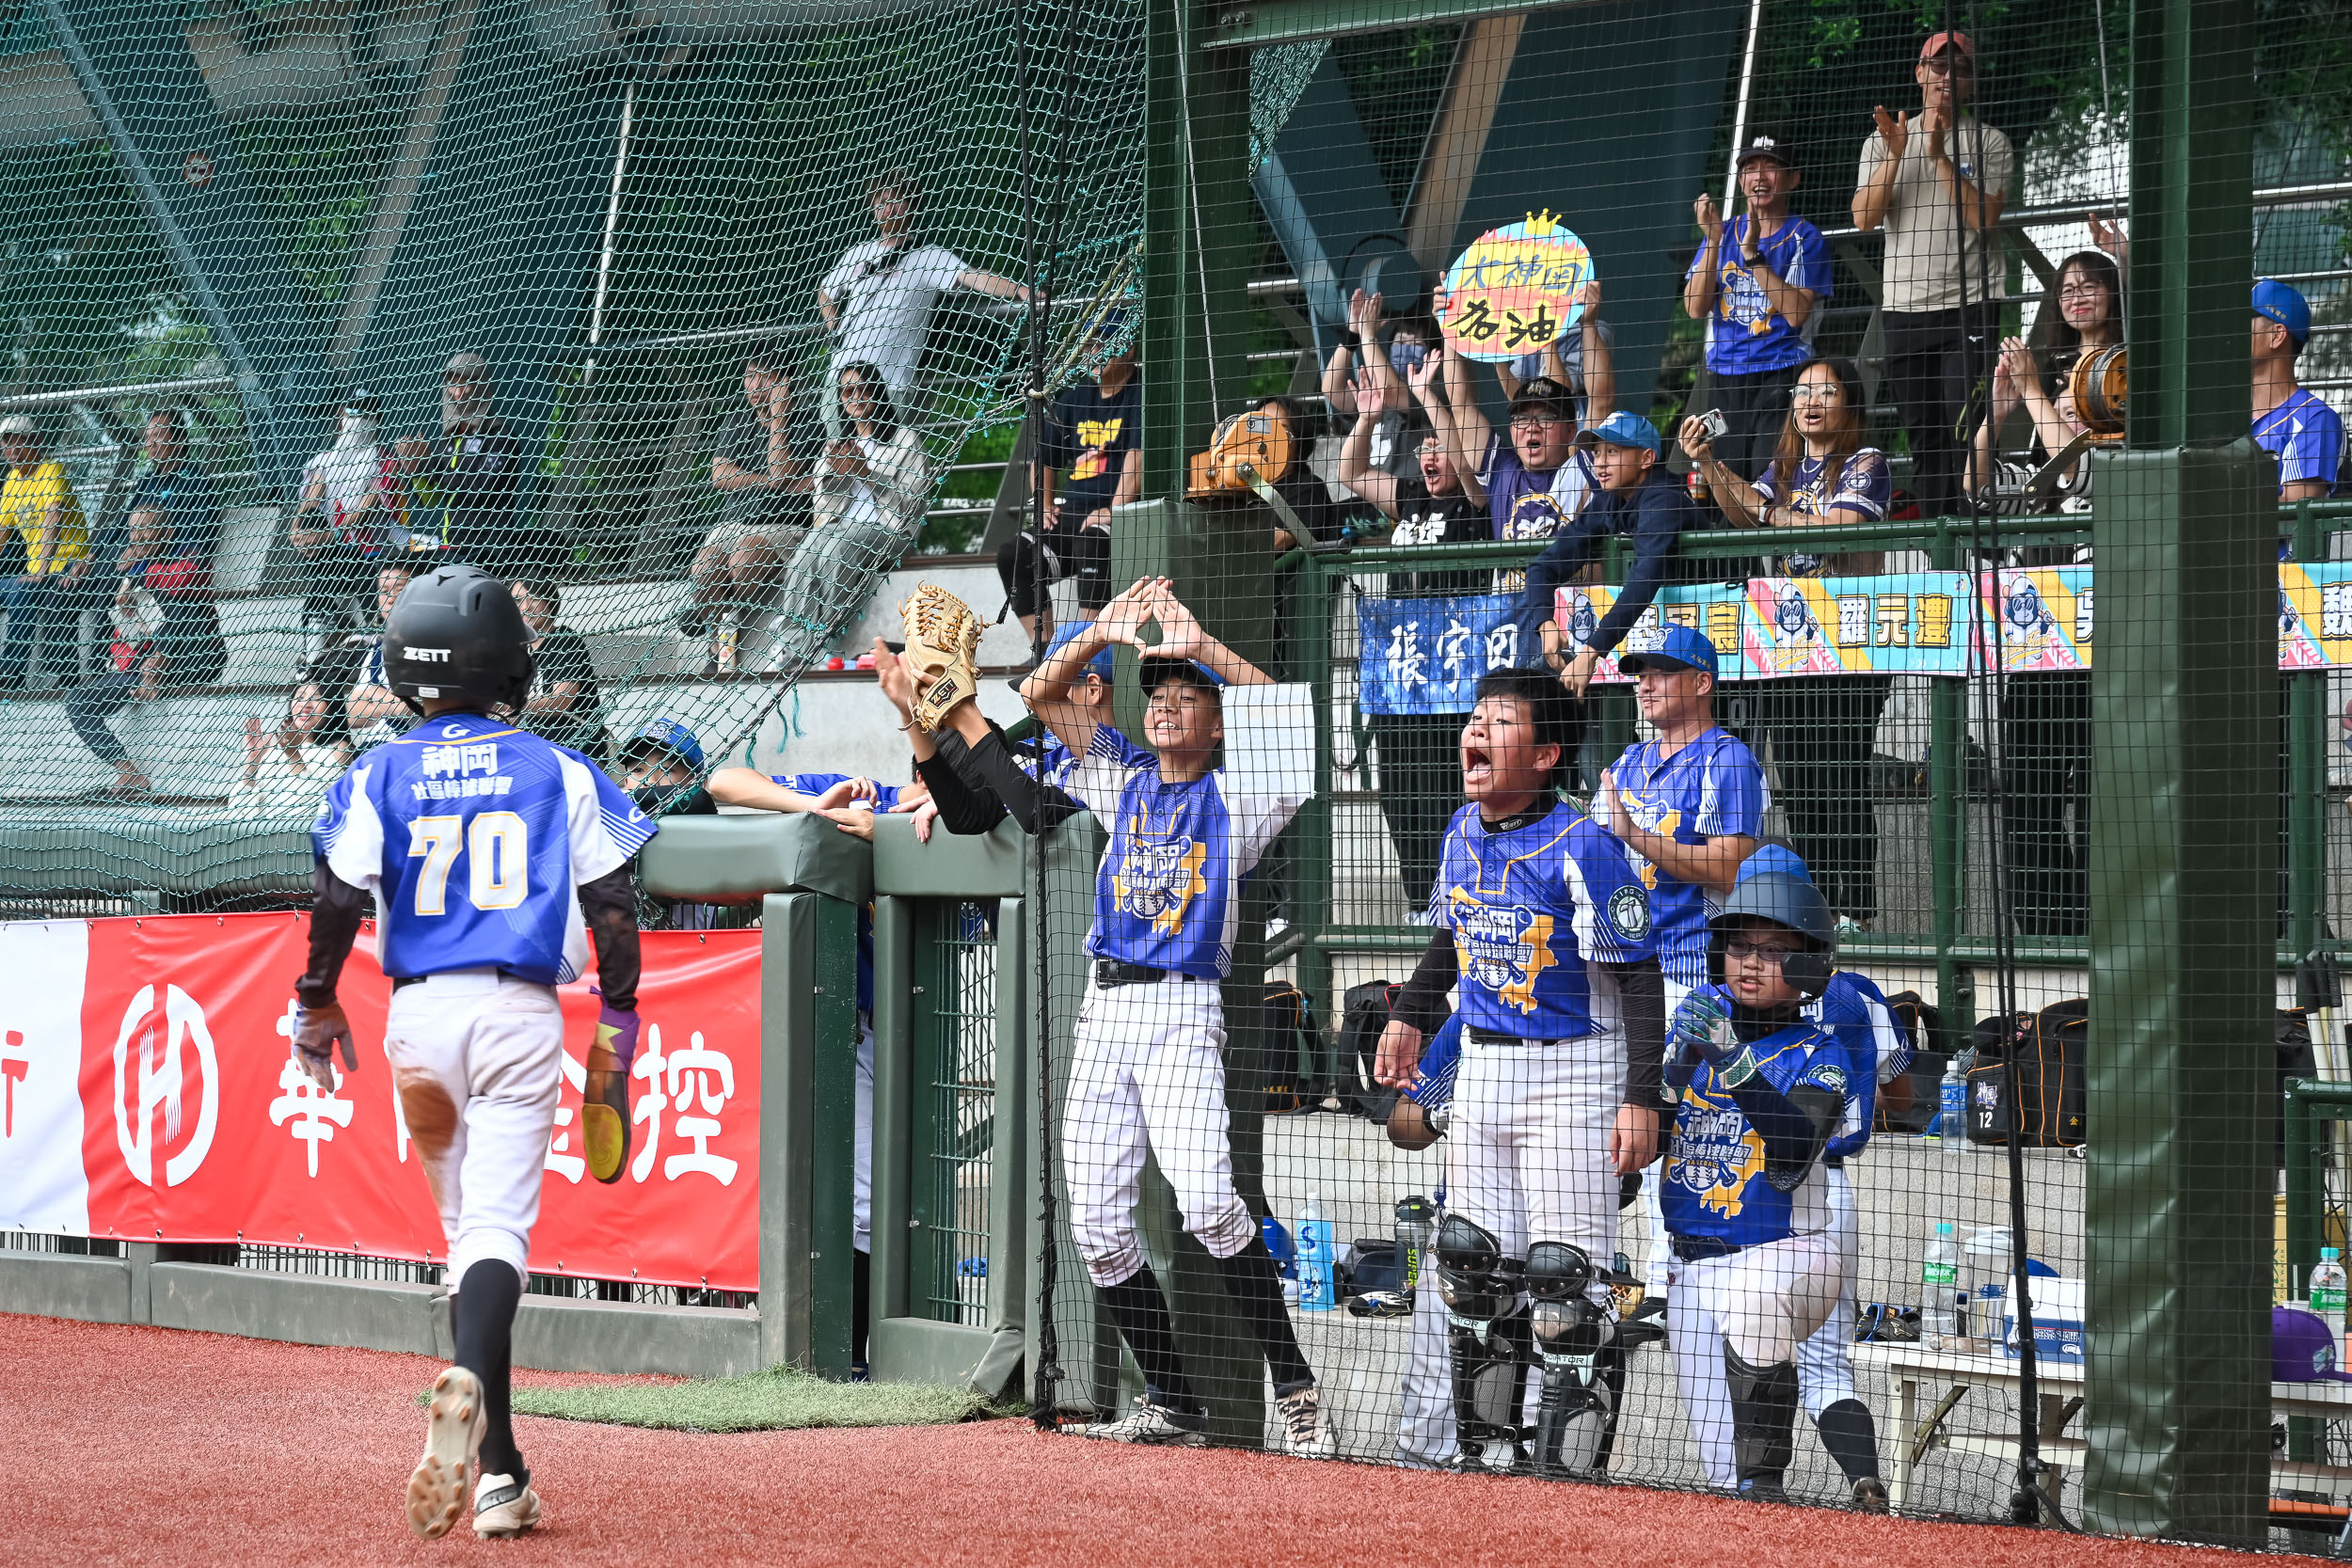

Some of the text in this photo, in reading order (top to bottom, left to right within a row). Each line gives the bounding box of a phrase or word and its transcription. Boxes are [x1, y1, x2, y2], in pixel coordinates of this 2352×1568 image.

[403, 646, 452, 662] ZETT
[930, 679, 955, 705] ZETT
[421, 742, 499, 780] 神岡
[410, 776, 514, 800] 社區棒球聯盟
[406, 810, 529, 916] 70
[1130, 844, 1180, 878] 神岡
[1465, 906, 1518, 944] 神岡
[269, 998, 739, 1187] 華控
[1683, 1110, 1744, 1145] 神岡
[1979, 1111, 1994, 1129] 12
[1686, 1159, 1720, 1169] BASEBALL
